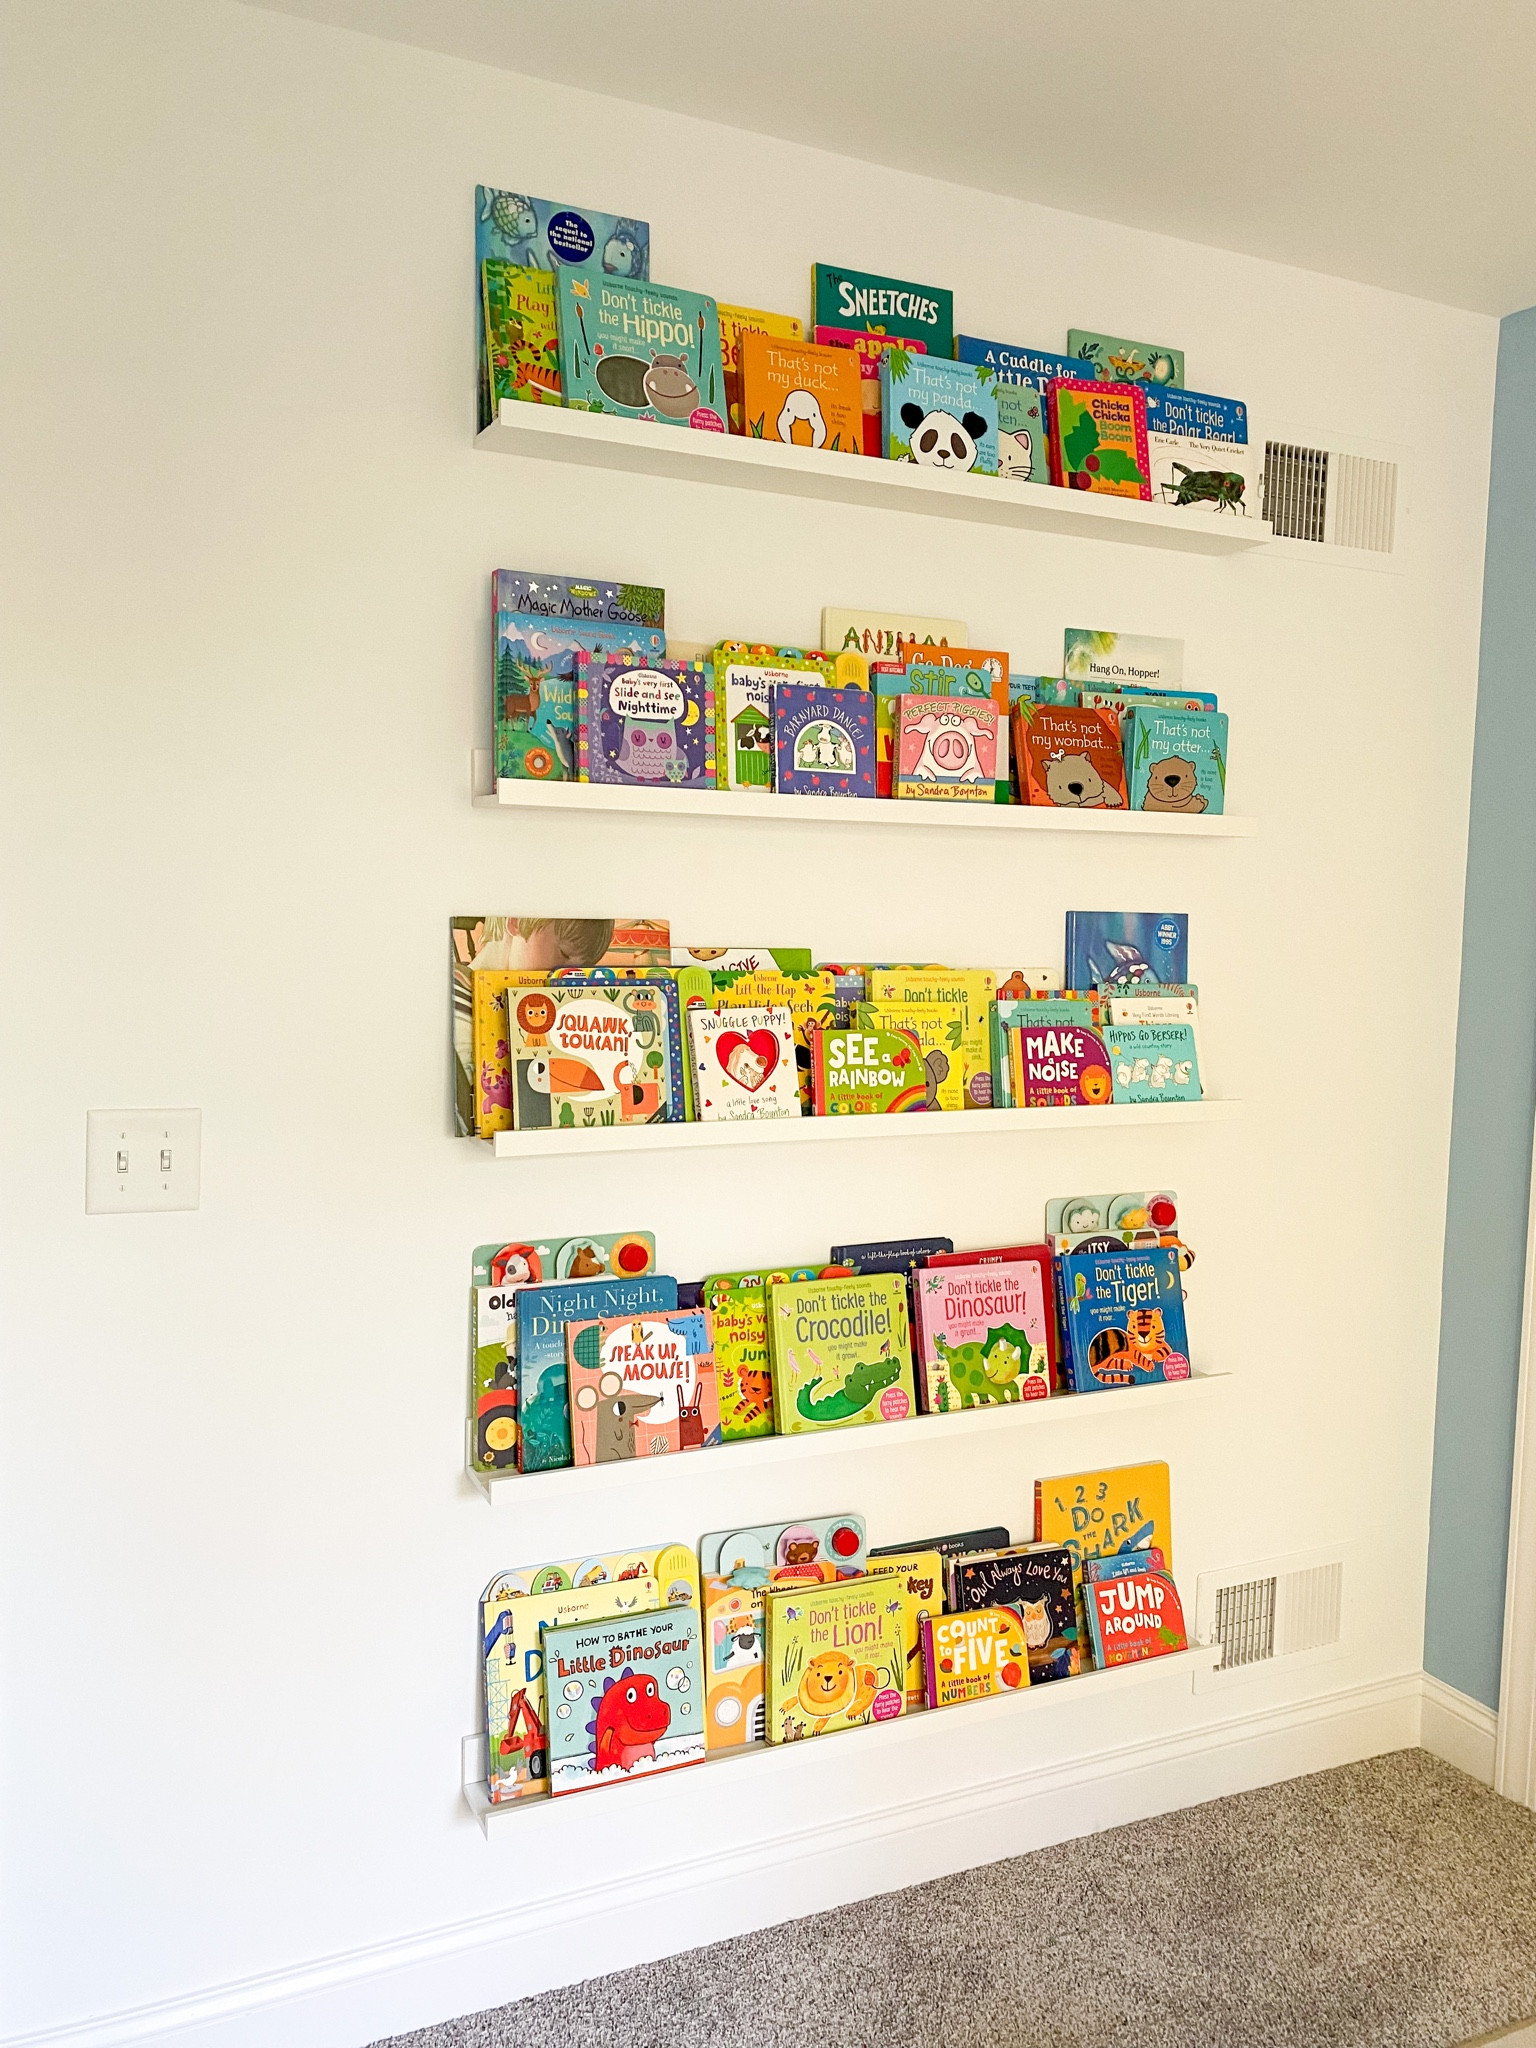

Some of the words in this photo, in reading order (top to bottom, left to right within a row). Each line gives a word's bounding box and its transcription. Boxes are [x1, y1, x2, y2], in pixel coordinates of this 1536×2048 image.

[565, 220, 578, 229] The
[578, 230, 588, 239] to
[826, 274, 842, 288] The
[516, 294, 549, 318] Play
[602, 289, 637, 312] Don't
[642, 297, 682, 320] tickle
[838, 282, 940, 324] SNEETCHES
[598, 309, 619, 326] the
[622, 312, 695, 349] Hippo!
[766, 350, 810, 372] That's
[814, 364, 838, 376] not
[984, 350, 996, 364] A
[1000, 352, 1052, 374] Cuddle
[1056, 363, 1077, 379] for
[768, 370, 790, 388] my
[793, 372, 839, 392] duck...
[912, 368, 952, 390] That's
[955, 380, 978, 396] not
[908, 388, 929, 405] my
[933, 392, 982, 411] panda...
[1002, 400, 1022, 412] not
[1092, 398, 1130, 412] Chicka
[1093, 410, 1130, 422] Chicka
[1165, 402, 1193, 422] Don't
[1196, 408, 1224, 428] tickle
[1100, 420, 1132, 432] Boom
[1153, 418, 1166, 432] the
[1169, 417, 1202, 437] Polar
[1100, 430, 1132, 442] Boom
[1200, 443, 1211, 452] Very
[1212, 445, 1226, 453] Quiet
[1226, 447, 1245, 455] Cricket
[518, 594, 556, 616] Magic
[560, 599, 603, 618] Mother
[608, 602, 647, 623] Goose
[1090, 663, 1111, 676] Hang
[1112, 666, 1126, 676] On,
[1128, 666, 1160, 679] Hopper!
[622, 678, 640, 687] Baby's
[731, 674, 766, 690] baby's
[910, 668, 956, 697] Stir
[614, 688, 640, 698] Slide
[642, 690, 661, 700] and
[664, 691, 680, 700] see
[618, 701, 677, 714] Nighttime
[904, 702, 949, 721] PERFECT
[950, 702, 994, 726] PIGGIES!
[784, 704, 829, 738] BARNYARD
[833, 707, 864, 740] DANCE!
[1040, 716, 1078, 734] That's
[1080, 723, 1102, 735] not
[1154, 720, 1188, 736] That's
[1191, 726, 1210, 738] not
[1032, 734, 1052, 750] my
[1054, 733, 1113, 750] wombat...
[1152, 740, 1170, 754] my
[1172, 740, 1210, 753] otter...
[906, 784, 916, 796] by
[916, 783, 949, 797] Sandra
[951, 786, 988, 798] Boynton
[1158, 931, 1177, 940] WINNER
[1160, 924, 1175, 932] ABBY
[754, 974, 778, 982] Usborne
[736, 984, 796, 998] Lift-the-Flap
[904, 987, 932, 1002] Don't
[937, 988, 968, 1002] tickle
[1135, 988, 1160, 997] Usborne
[787, 1000, 814, 1014] Seek
[556, 1014, 633, 1038] SQUAWK,
[701, 1017, 748, 1031] SNUGGLE
[752, 1012, 786, 1028] PUPPY!
[880, 1014, 917, 1030] That's
[921, 1018, 942, 1030] not
[1026, 1030, 1085, 1060] MAKE
[1110, 1030, 1136, 1044] HIPPOS
[1138, 1030, 1150, 1040] GO
[1150, 1028, 1188, 1042] BERSERK!
[828, 1033, 880, 1068] SEE
[882, 1053, 892, 1063] a
[829, 1068, 906, 1090] RAINBOW
[1028, 1060, 1078, 1082] NOISE
[732, 1098, 746, 1106] little
[748, 1096, 760, 1104] love
[762, 1096, 778, 1105] song
[830, 1100, 878, 1114] COLORS
[1030, 1094, 1078, 1107] SOUNDS
[1137, 1094, 1158, 1103] Sandra
[1159, 1093, 1186, 1102] Boynton
[730, 1110, 755, 1120] Sandra
[1088, 1241, 1110, 1255] ITSY
[1095, 1264, 1122, 1282] Don't
[1125, 1262, 1155, 1279] tickle
[948, 1280, 972, 1296] Don't
[974, 1280, 1002, 1293] tickle
[1004, 1278, 1020, 1291] the
[1096, 1286, 1112, 1300] the
[1110, 1277, 1161, 1307] Tiger!
[540, 1294, 597, 1318] Night
[604, 1286, 664, 1310] Night,
[796, 1294, 827, 1314] Don't
[832, 1292, 866, 1310] tickle
[869, 1292, 887, 1306] the
[944, 1291, 1026, 1320] Dinosaur!
[716, 1314, 752, 1329] baby's
[796, 1308, 892, 1343] Crocodile!
[730, 1329, 766, 1344] noisy
[610, 1343, 657, 1362] SPEAK
[658, 1342, 680, 1362] UP,
[623, 1360, 690, 1383] MOUSE!
[1072, 1506, 1104, 1533] DO
[1062, 1497, 1144, 1572] SHARK
[1082, 1531, 1097, 1541] THE
[948, 1542, 964, 1550] books
[873, 1566, 894, 1576] FEED
[896, 1563, 918, 1573] YOUR
[970, 1574, 994, 1602] Owl
[990, 1562, 1022, 1586] Always
[1026, 1561, 1051, 1579] Love
[1053, 1566, 1068, 1584] You
[752, 1589, 767, 1599] The
[1099, 1581, 1165, 1615] JUMP
[558, 1603, 589, 1614] Usborne
[751, 1600, 764, 1608] on
[810, 1606, 839, 1626] Don't
[844, 1600, 876, 1620] tickle
[811, 1628, 829, 1643] the
[833, 1614, 883, 1648] Lion!
[936, 1616, 999, 1643] COUNT
[1106, 1612, 1162, 1636] AROUND
[576, 1636, 600, 1649] HOW
[602, 1634, 616, 1644] TO
[618, 1628, 648, 1642] BATHE
[650, 1622, 674, 1635] YOUR
[880, 1642, 894, 1650] make
[557, 1650, 606, 1678] Little
[609, 1638, 690, 1668] Dinosaur
[940, 1646, 952, 1656] to
[954, 1636, 1010, 1676] FIVE
[966, 1675, 982, 1684] book
[942, 1682, 991, 1702] NUMBERS
